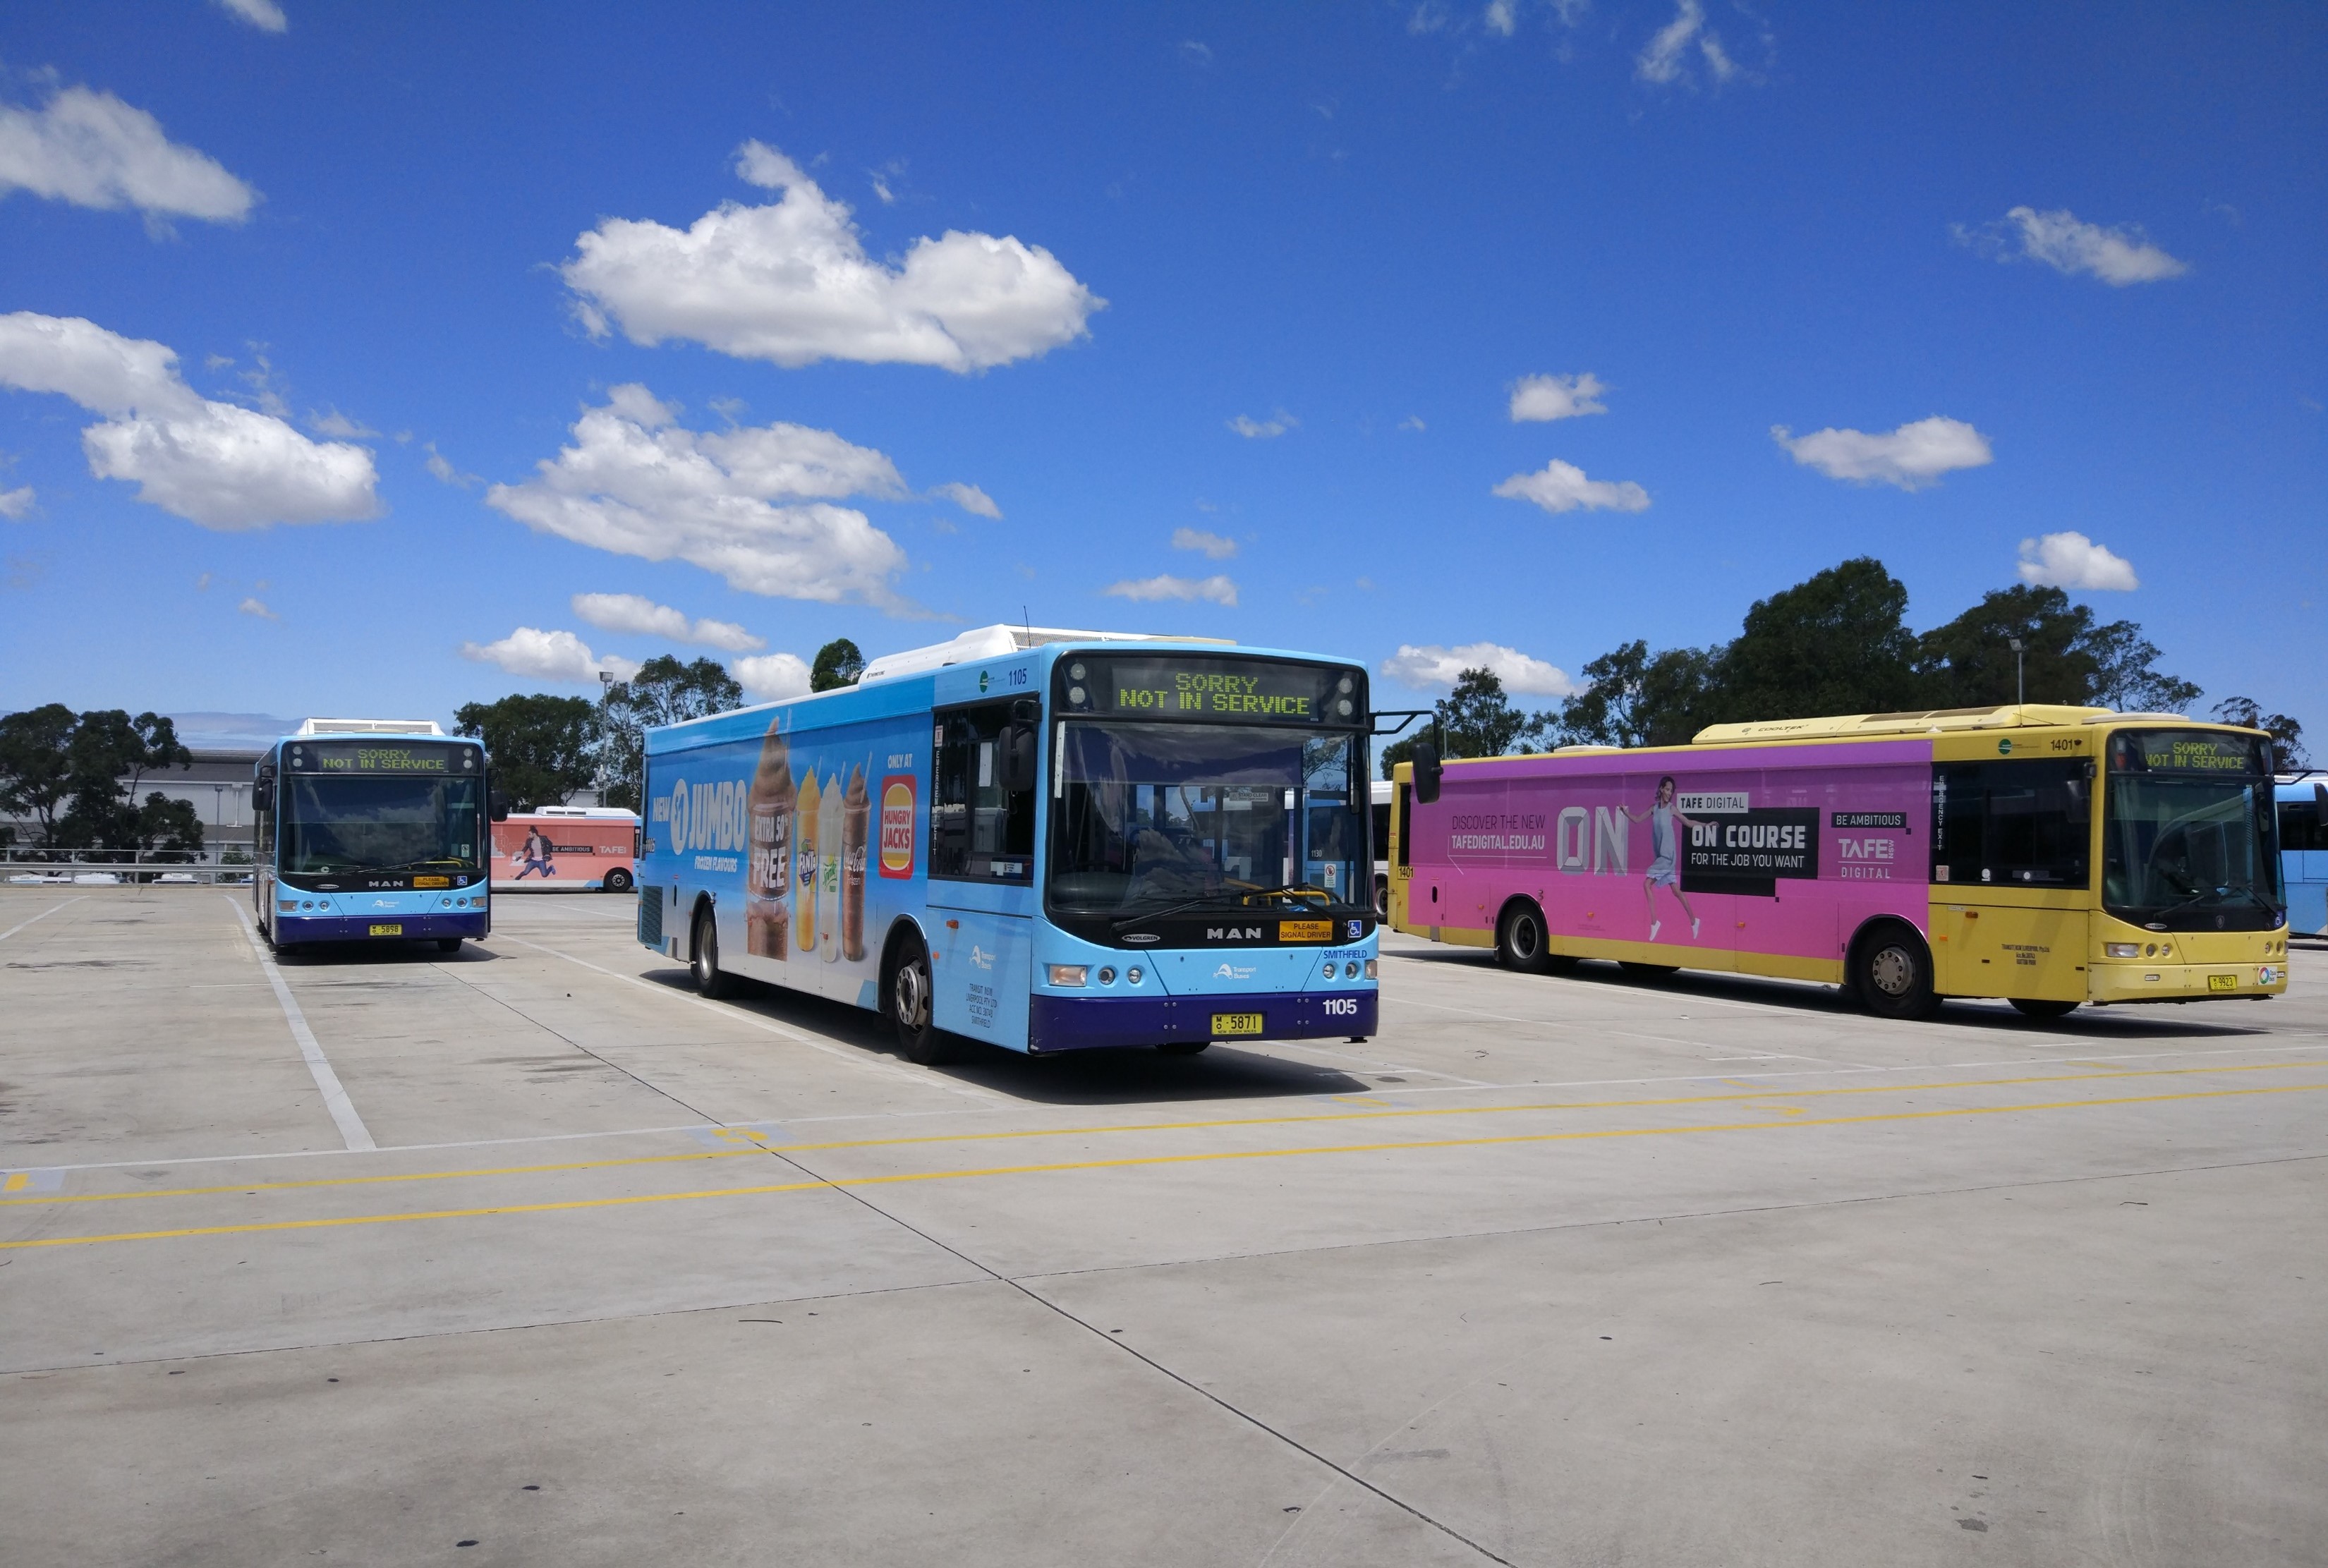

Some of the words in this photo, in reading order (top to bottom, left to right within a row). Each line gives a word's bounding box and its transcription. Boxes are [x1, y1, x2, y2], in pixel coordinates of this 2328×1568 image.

[1009, 668, 1027, 686] 1105
[1175, 673, 1258, 693] SORRY
[1120, 689, 1168, 708] NOT
[1179, 692, 1201, 710] IN
[1213, 694, 1310, 715] SERVICE
[2051, 739, 2073, 751] 1401
[2173, 741, 2218, 755] SORRY
[358, 749, 411, 760] SORRY
[887, 755, 904, 769] ONLY
[904, 753, 913, 768] AT
[2174, 755, 2187, 767] IN
[2192, 756, 2245, 769] SERVICE
[323, 758, 353, 768] NOT
[360, 759, 375, 769] IN
[382, 760, 444, 770] SERVICE
[1681, 797, 1702, 809] TAFE
[1706, 797, 1744, 808] DIGITAL
[653, 797, 670, 822] NEW
[689, 779, 746, 852] JUMBO
[885, 810, 910, 825] HUNGRY
[1453, 815, 1497, 829] DISCOVER
[1500, 815, 1518, 829] THE
[1521, 815, 1545, 829] NEW
[1836, 815, 1848, 825] BE
[1850, 815, 1900, 825] AMBITIOUS
[754, 815, 775, 842] EXTRA
[1452, 835, 1545, 850] TAFEDIGITAL.EDU.AU
[1557, 806, 1628, 876] ON
[1692, 825, 1717, 846] ON
[1726, 825, 1806, 849] COURSE
[1838, 839, 1889, 858] TAFE
[695, 856, 713, 870] FROZEN
[713, 857, 737, 873] FLAVOURS
[753, 846, 786, 888] FREE
[1691, 853, 1708, 865] FOR
[1711, 853, 1728, 865] THE
[1730, 854, 1750, 867] JOB
[1752, 855, 1772, 867] YOU
[1774, 855, 1805, 868] WANT
[1399, 868, 1414, 878] 1401
[1841, 867, 1891, 879] DIGITAL
[1207, 928, 1261, 940] MAN
[1323, 950, 1367, 959] SMITHFIELD
[2219, 977, 2233, 987] 9923
[1323, 999, 1357, 1014] 1105
[1231, 1016, 1256, 1029] 5871
